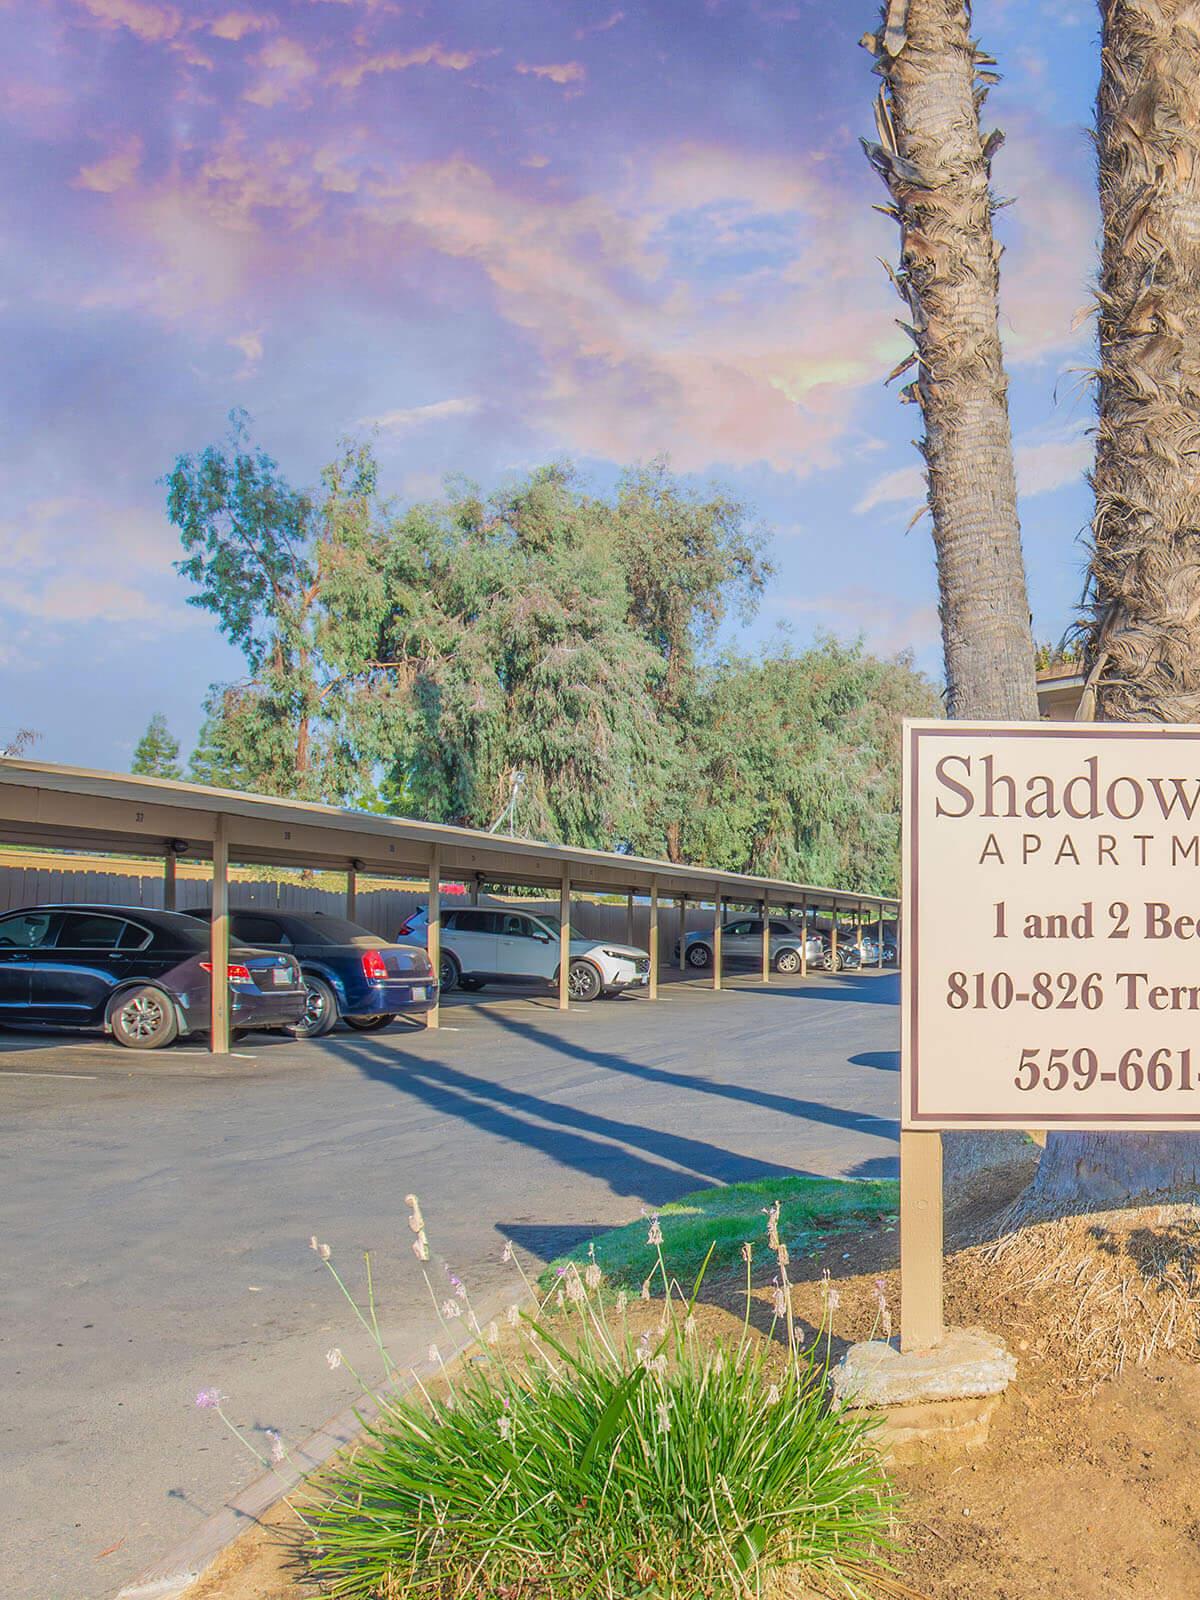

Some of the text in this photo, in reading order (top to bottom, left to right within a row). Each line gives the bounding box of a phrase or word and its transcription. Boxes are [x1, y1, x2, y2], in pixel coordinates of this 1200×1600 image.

[992, 900, 1009, 939] 1
[1022, 901, 1096, 940] and
[1107, 901, 1131, 940] 2
[946, 971, 1104, 1011] 810-826
